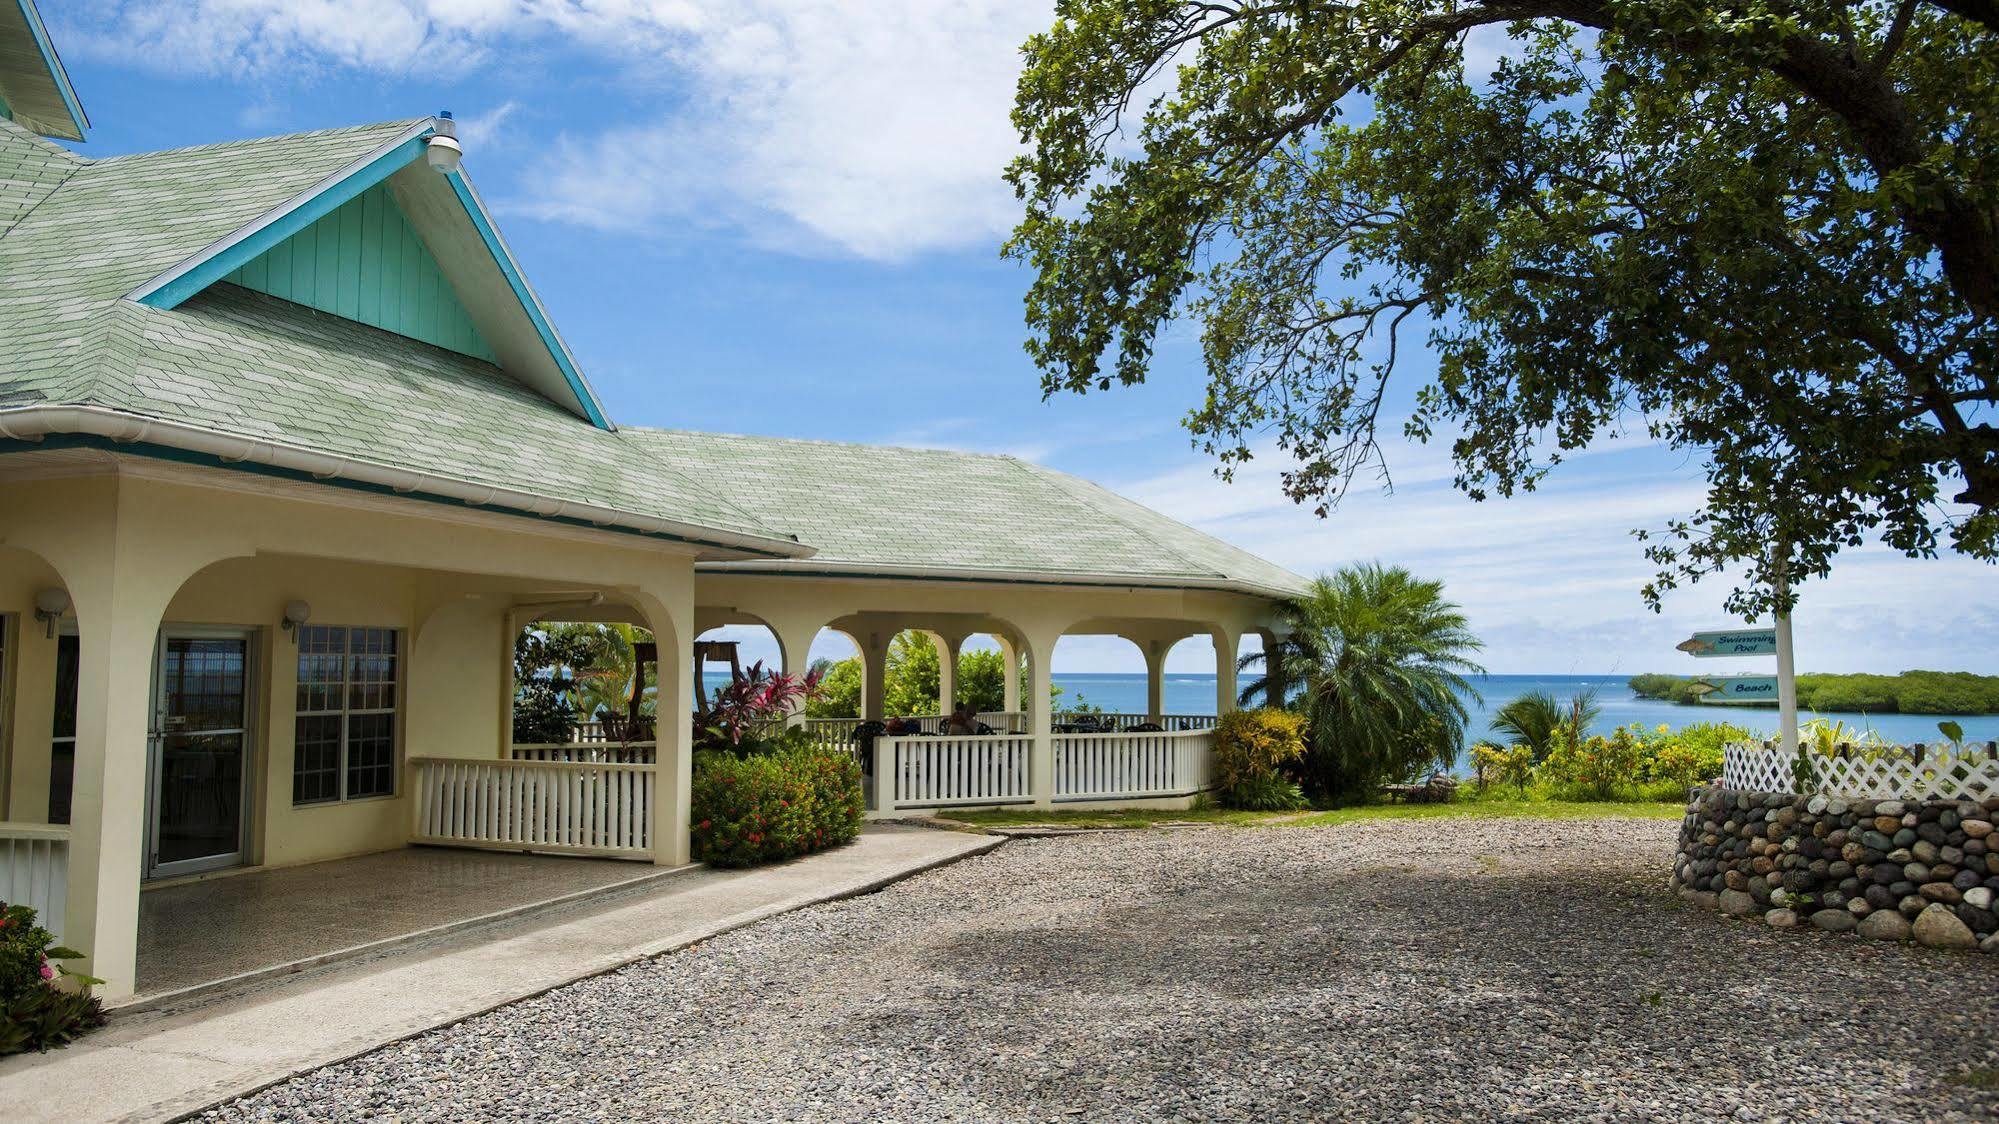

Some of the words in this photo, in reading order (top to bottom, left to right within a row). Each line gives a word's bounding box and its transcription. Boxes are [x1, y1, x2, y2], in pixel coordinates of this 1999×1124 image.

[1718, 635, 1776, 644] Swimming
[1734, 644, 1757, 652] Pool
[1735, 684, 1772, 692] Beach
